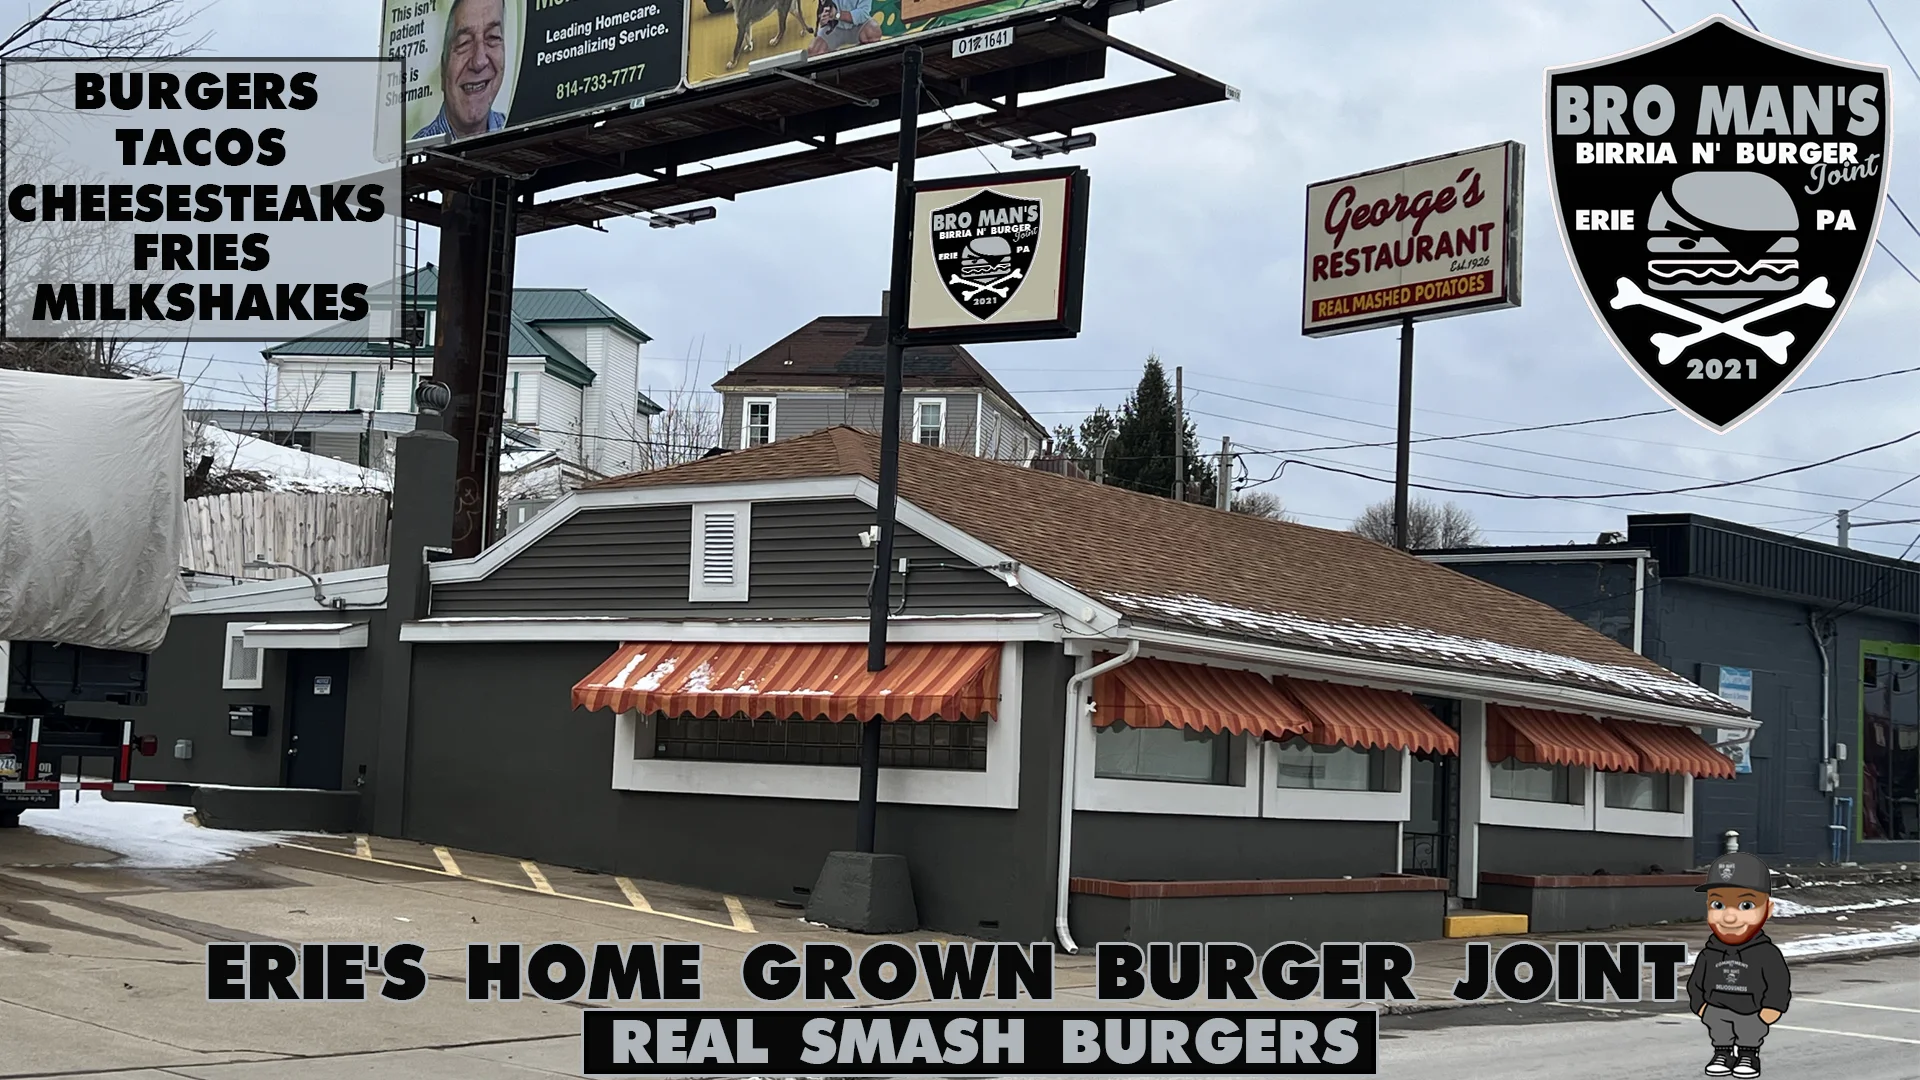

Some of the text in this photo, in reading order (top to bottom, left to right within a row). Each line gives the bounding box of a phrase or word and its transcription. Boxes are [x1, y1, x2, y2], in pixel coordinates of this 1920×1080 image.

[392, 0, 436, 24] This isn't
[546, 21, 592, 44] Leading
[595, 4, 660, 31] Homecare.
[390, 19, 425, 46] patient
[536, 23, 669, 66] Personalizing Service.
[388, 39, 428, 62] 543776.
[410, 67, 419, 82] is
[556, 63, 646, 100] 814-733-7777
[934, 205, 1039, 232] BRO MAN'S
[1325, 167, 1486, 250] George's
[940, 230, 972, 240] BIRRIA
[991, 224, 1031, 235] BURGER
[1012, 226, 1038, 242] Joint
[938, 252, 958, 260] ERIE
[1016, 246, 1030, 254] PA
[1312, 222, 1495, 282] RESTAURANT
[973, 297, 997, 306] 2021
[1318, 274, 1486, 318] REAL MASHED POTATOES
